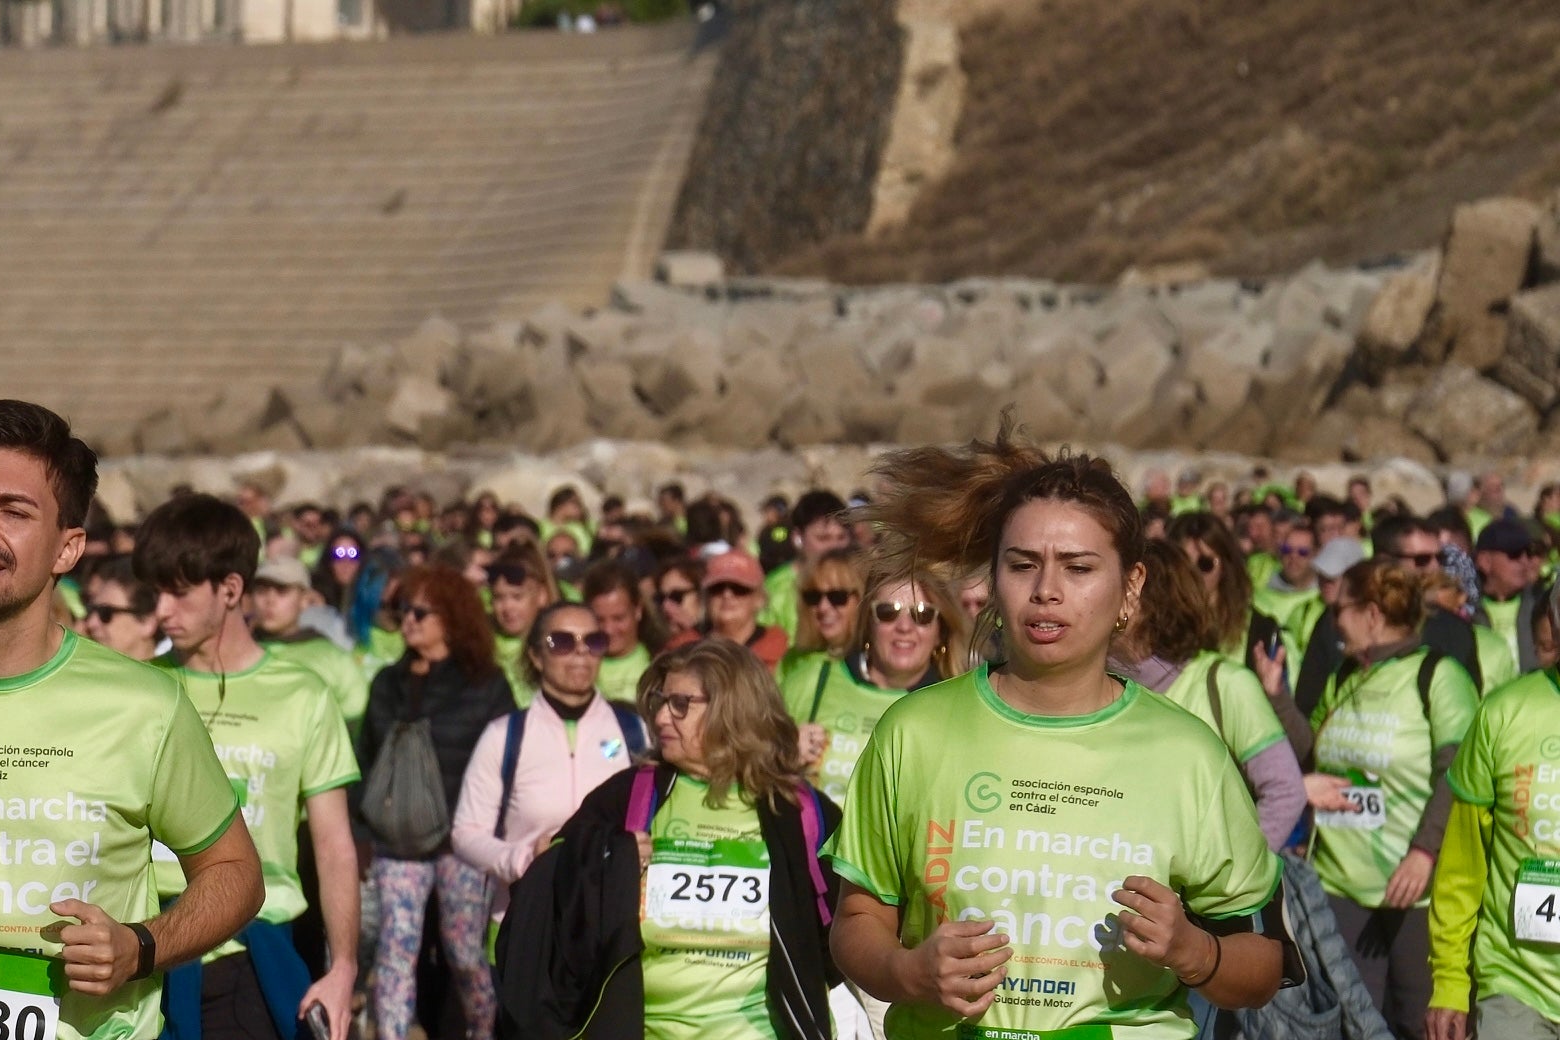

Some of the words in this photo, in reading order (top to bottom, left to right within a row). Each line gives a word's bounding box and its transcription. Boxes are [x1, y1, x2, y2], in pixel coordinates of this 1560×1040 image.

[23, 746, 74, 758] española
[832, 734, 858, 753] En
[0, 757, 10, 768] el
[13, 758, 50, 769] cáncer
[216, 743, 277, 769] archa
[1011, 778, 1071, 792] asociación
[1073, 784, 1124, 800] española
[1010, 790, 1046, 802] contra
[1049, 793, 1059, 802] el
[1061, 795, 1100, 808] cáncer
[1009, 803, 1023, 811] en
[1025, 803, 1057, 815] Cádiz
[65, 832, 100, 866] el
[962, 820, 1005, 849] En
[1016, 828, 1154, 866] marcha
[670, 872, 762, 904] 2573
[954, 864, 1097, 902] contra
[1535, 893, 1560, 923] 4
[959, 897, 1120, 952] cánce
[1035, 957, 1068, 967] CONTRA
[997, 977, 1076, 995] HYUNDAI
[1043, 998, 1073, 1008] Motor
[985, 1030, 999, 1038] en
